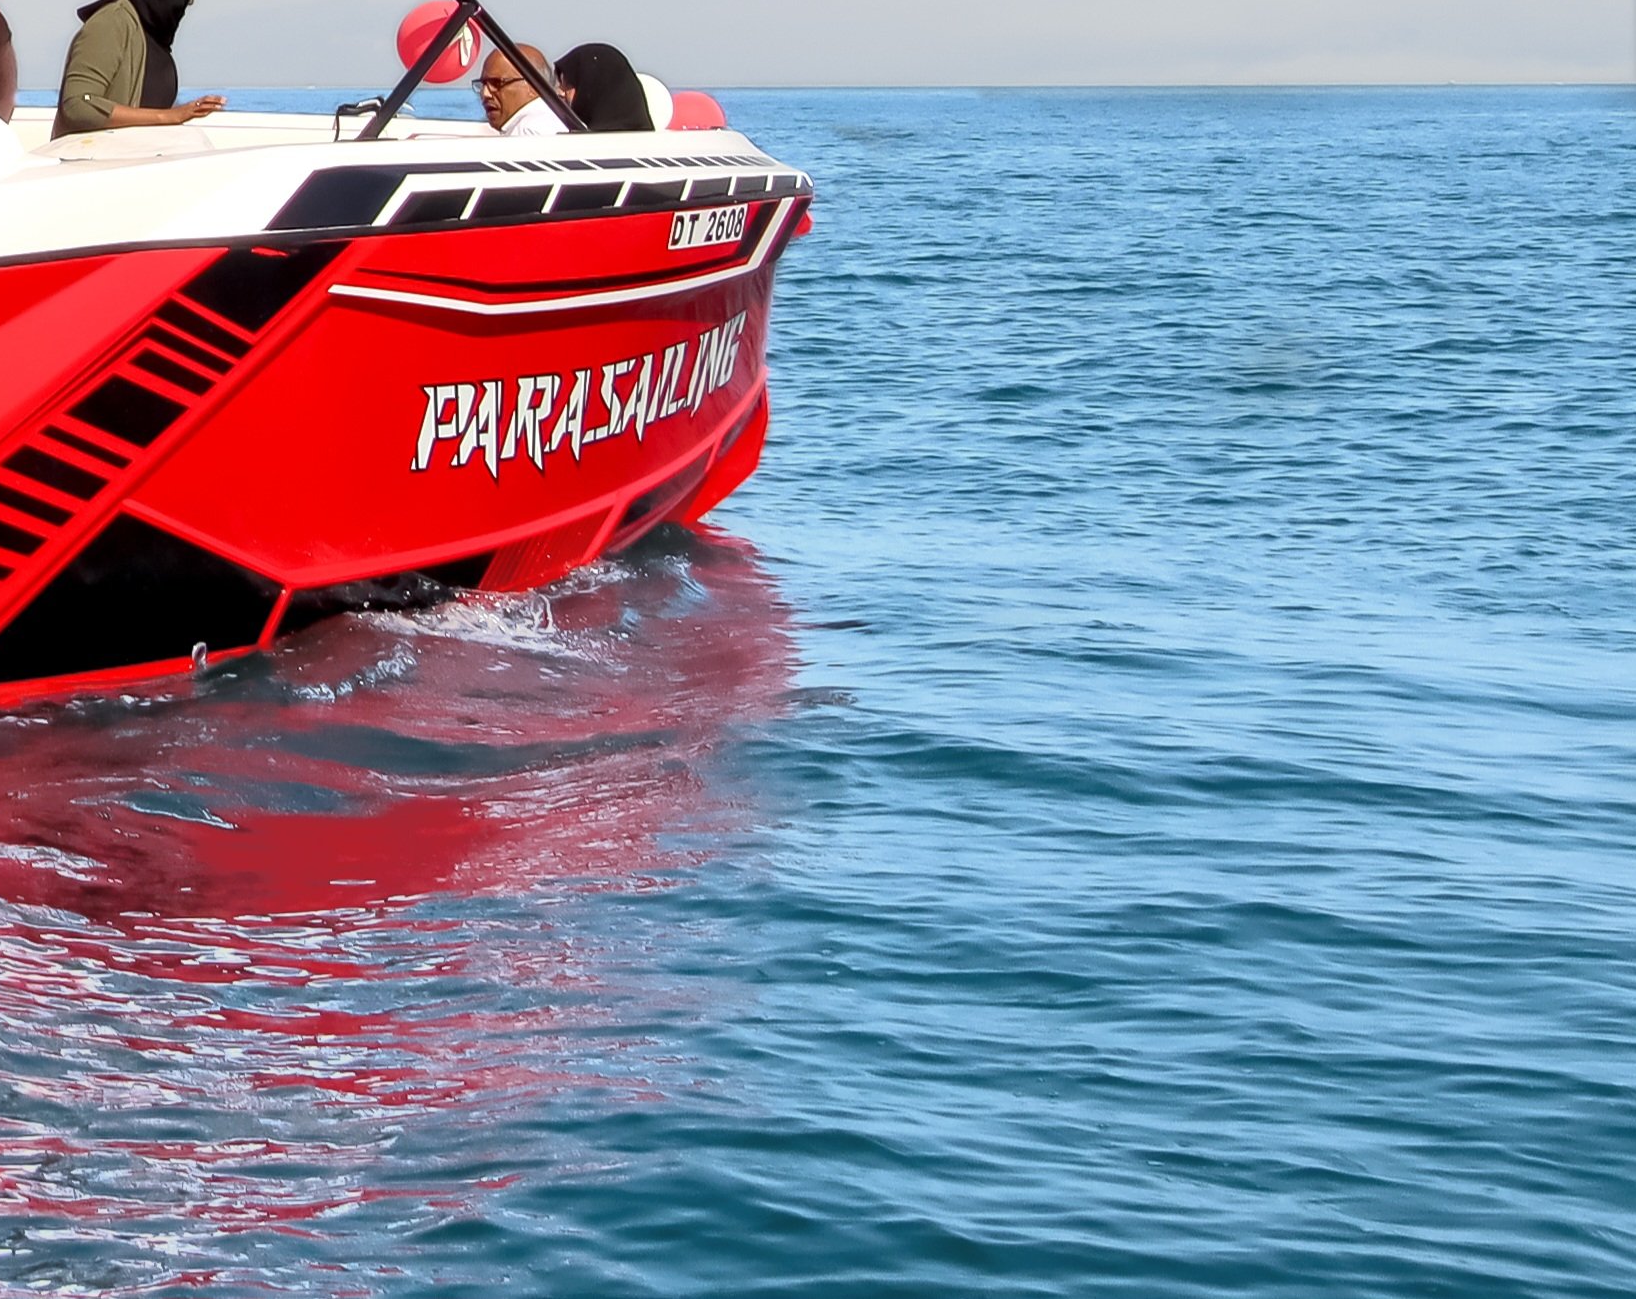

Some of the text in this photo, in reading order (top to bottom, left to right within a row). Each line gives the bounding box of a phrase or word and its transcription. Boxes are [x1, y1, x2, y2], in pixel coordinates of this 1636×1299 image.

[671, 207, 745, 246] DT 2608
[410, 310, 746, 479] PARASAILING
